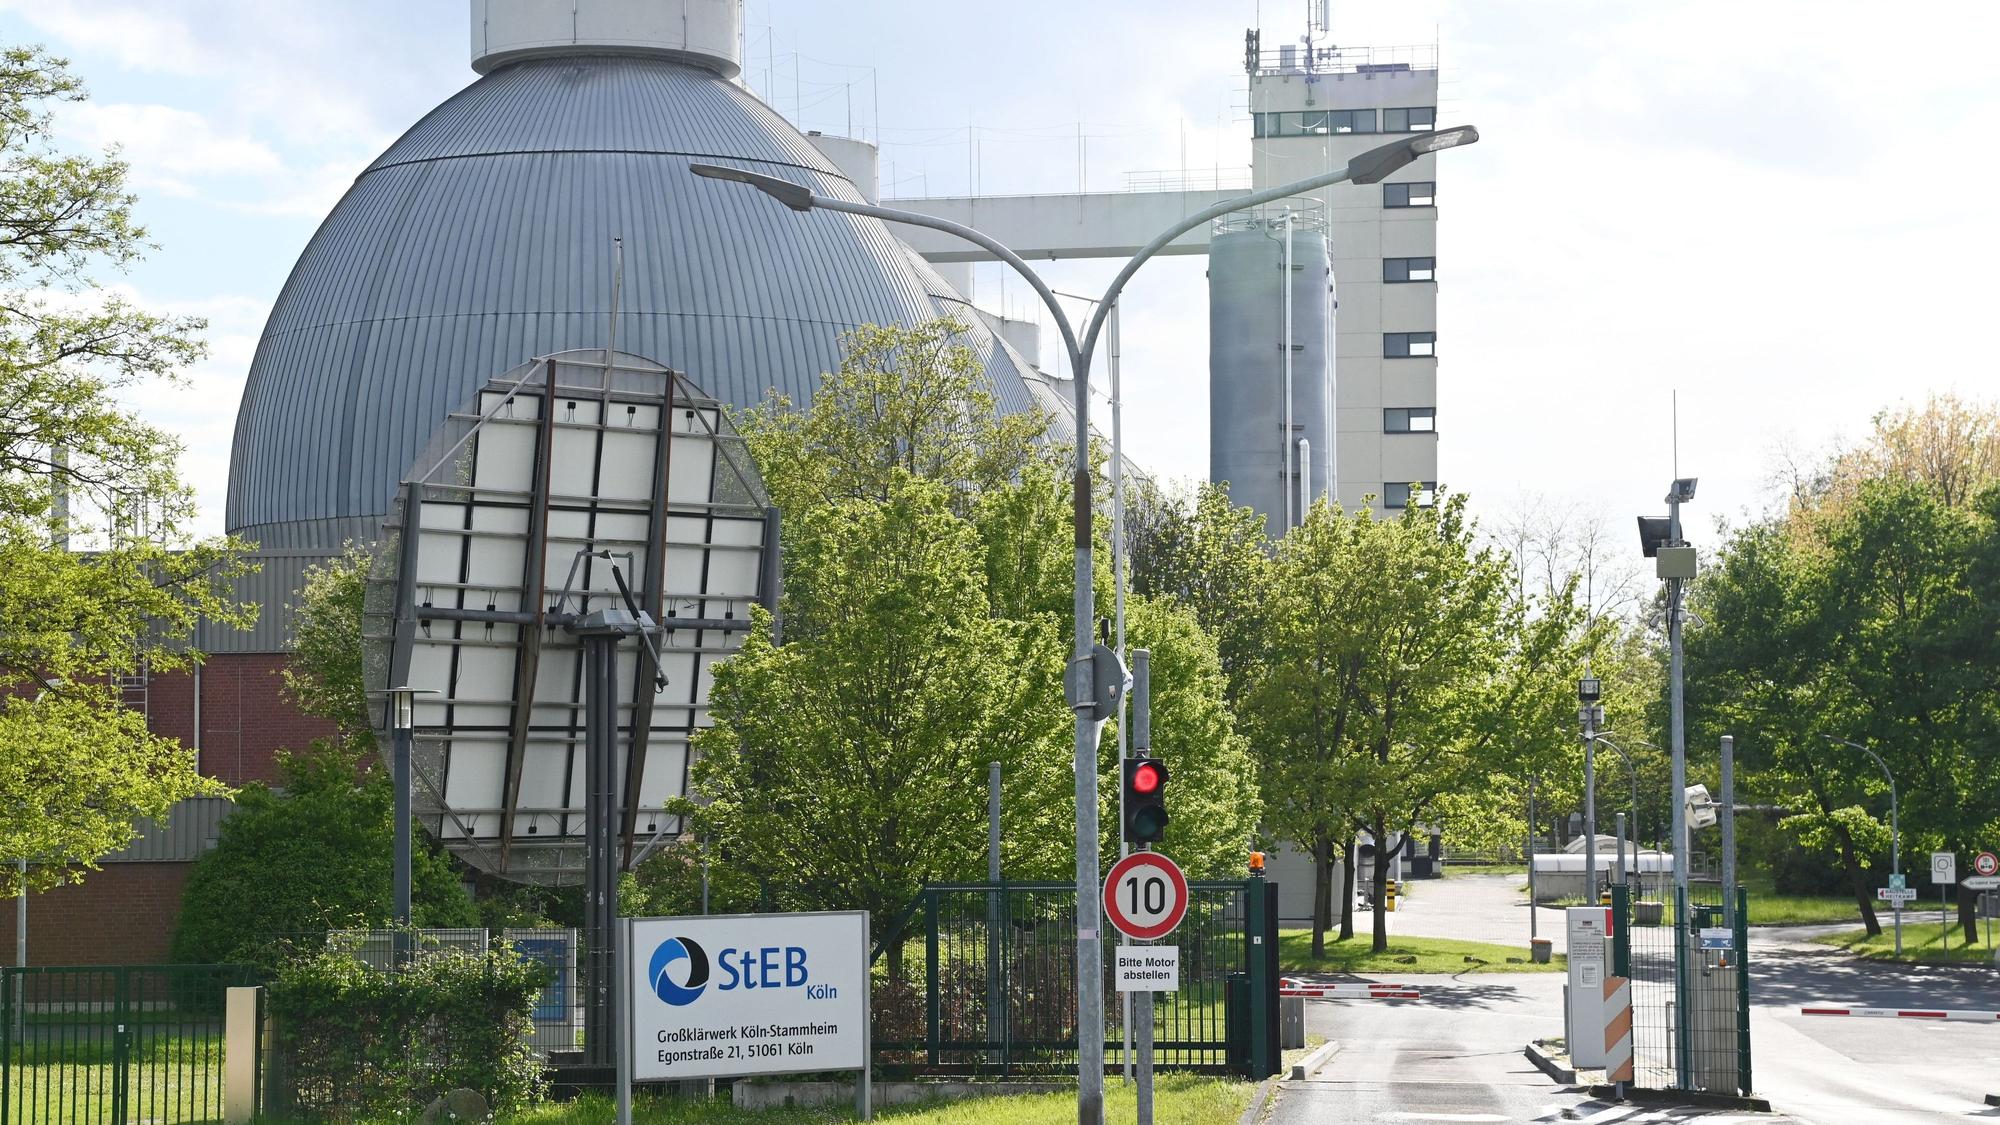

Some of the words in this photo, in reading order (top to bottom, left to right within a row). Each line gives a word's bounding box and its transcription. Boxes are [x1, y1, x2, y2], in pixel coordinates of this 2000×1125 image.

[1126, 877, 1166, 915] 10
[718, 946, 808, 991] StEB
[1119, 957, 1143, 967] Bitte
[1145, 957, 1176, 967] Motor
[1123, 970, 1170, 980] abstellen
[806, 984, 837, 1000] Köln
[657, 1026, 737, 1043] Großklärwerk
[741, 1022, 838, 1039] Köln-Stammheim
[657, 1046, 724, 1065] Egonstraße
[727, 1045, 744, 1061] 21,
[748, 1043, 783, 1058] 51061
[788, 1042, 813, 1056] Köln
